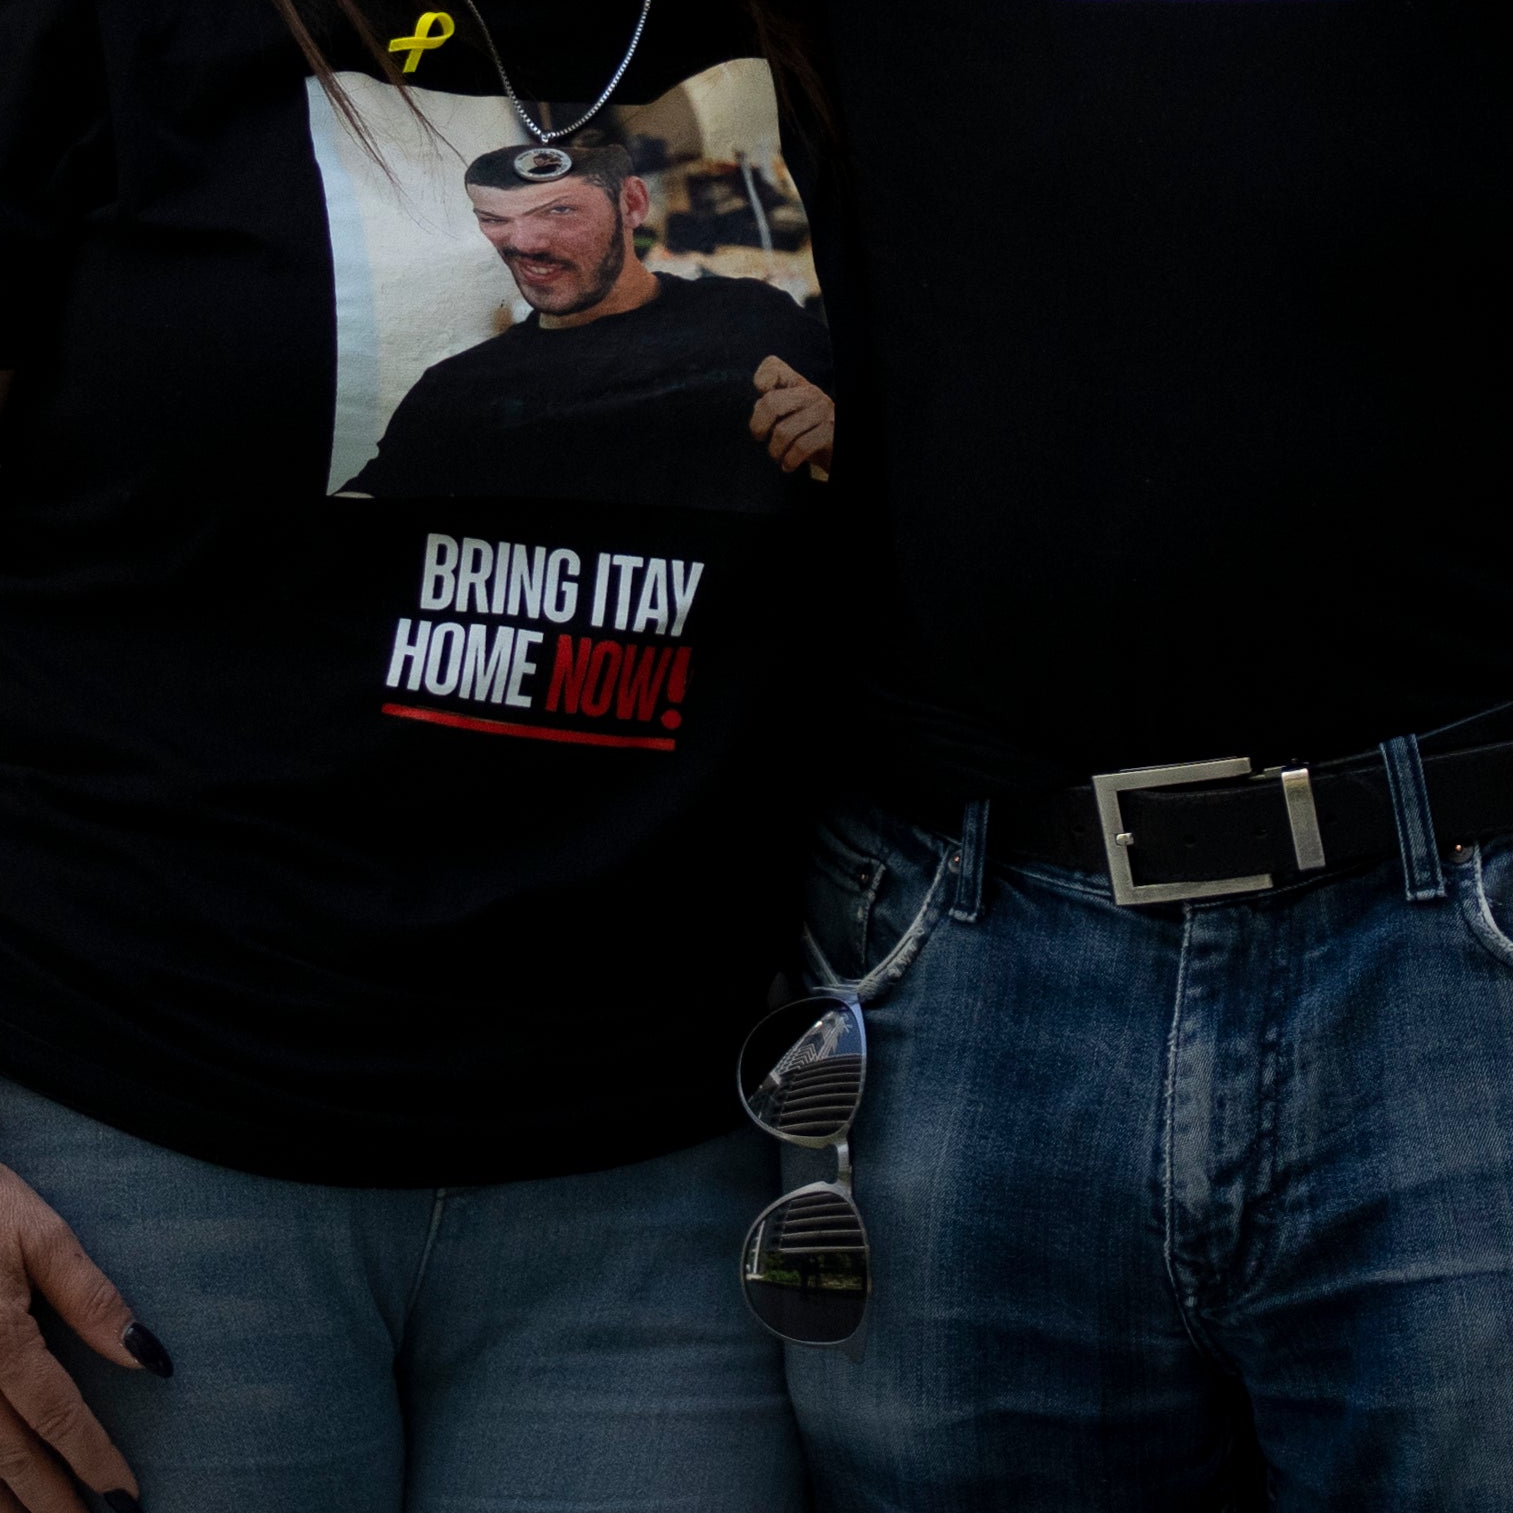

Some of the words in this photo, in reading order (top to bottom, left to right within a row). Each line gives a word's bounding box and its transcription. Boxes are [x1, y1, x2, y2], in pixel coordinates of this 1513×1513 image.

[419, 532, 582, 624] BRING
[591, 552, 705, 637] ITAY
[385, 617, 544, 708] HOME
[545, 633, 693, 731] NOW!
